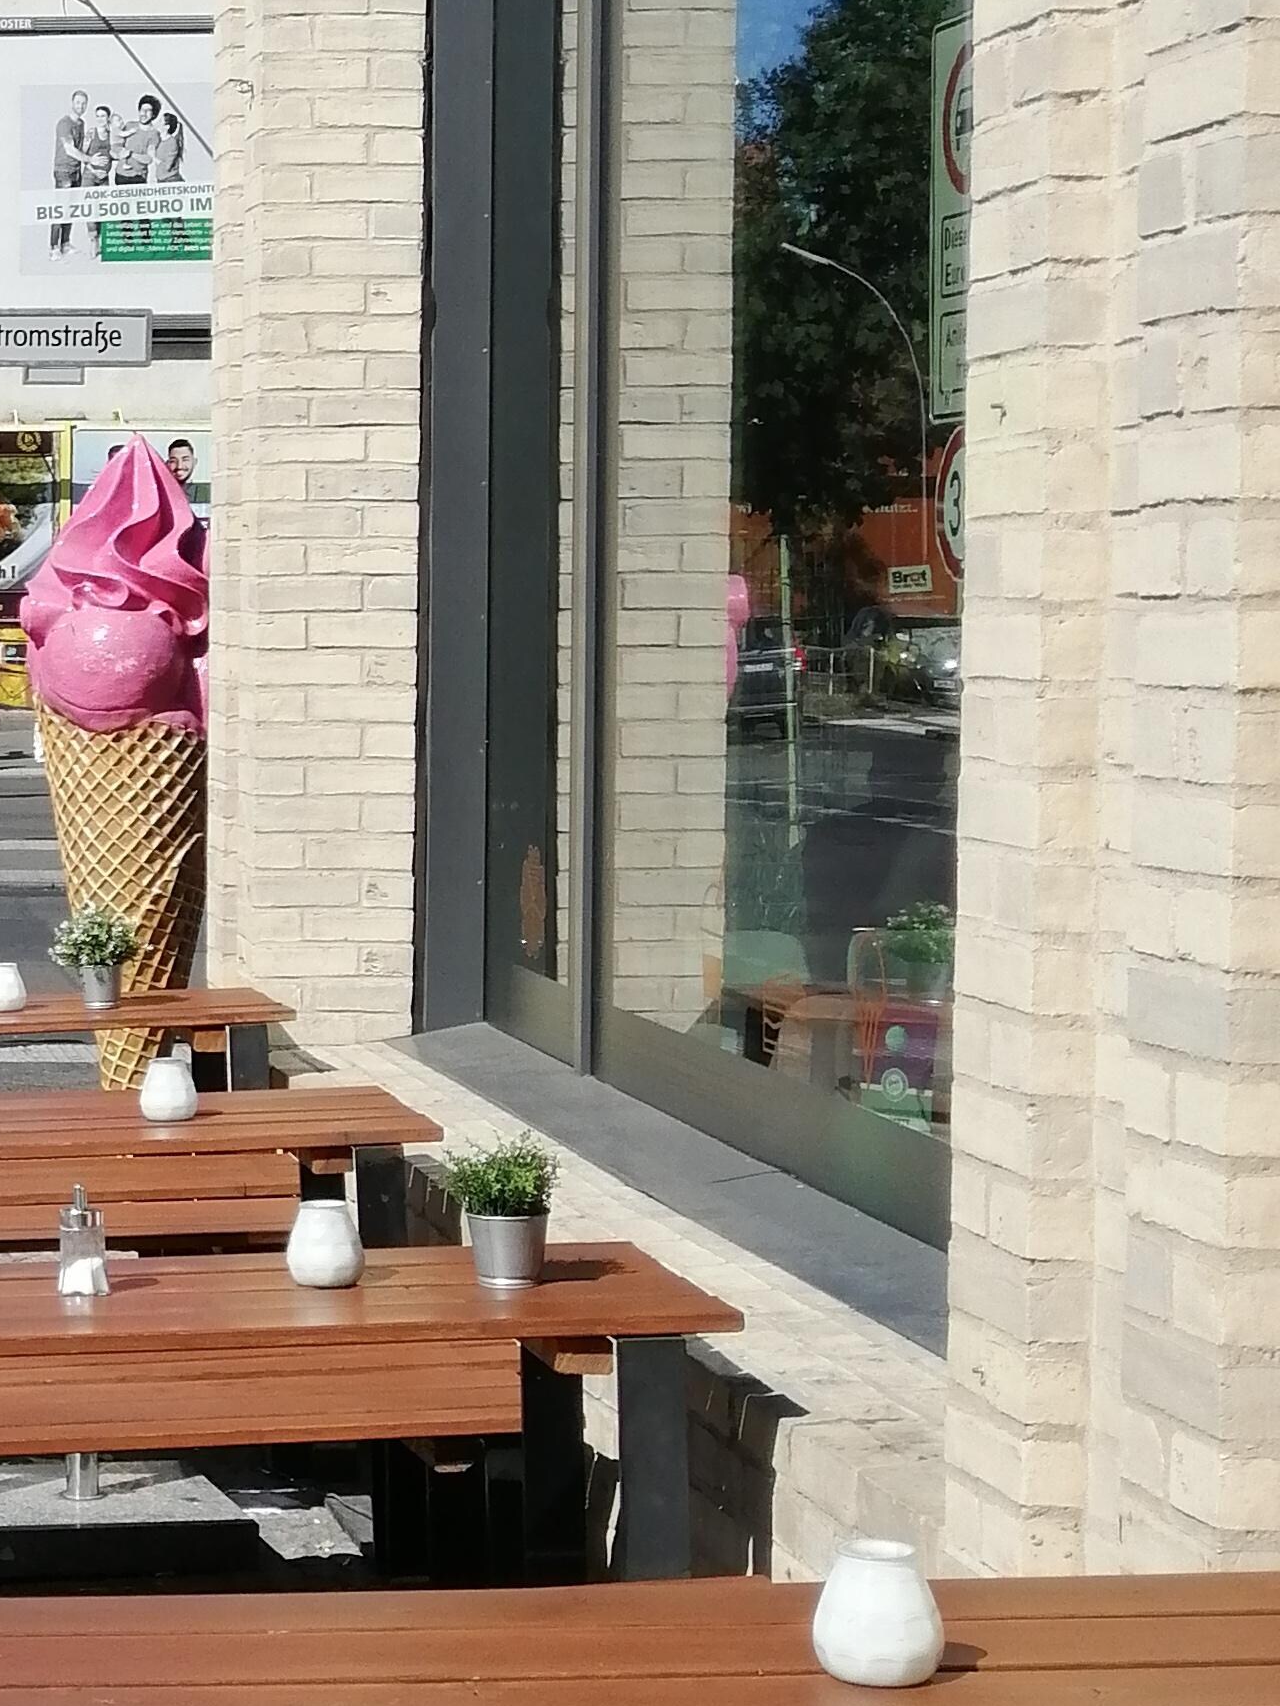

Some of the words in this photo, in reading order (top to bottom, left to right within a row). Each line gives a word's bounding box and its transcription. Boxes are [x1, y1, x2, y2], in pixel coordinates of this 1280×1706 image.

[37, 205, 63, 219] BIS
[69, 204, 91, 218] ZU
[99, 202, 130, 216] 500
[137, 199, 183, 214] EURO
